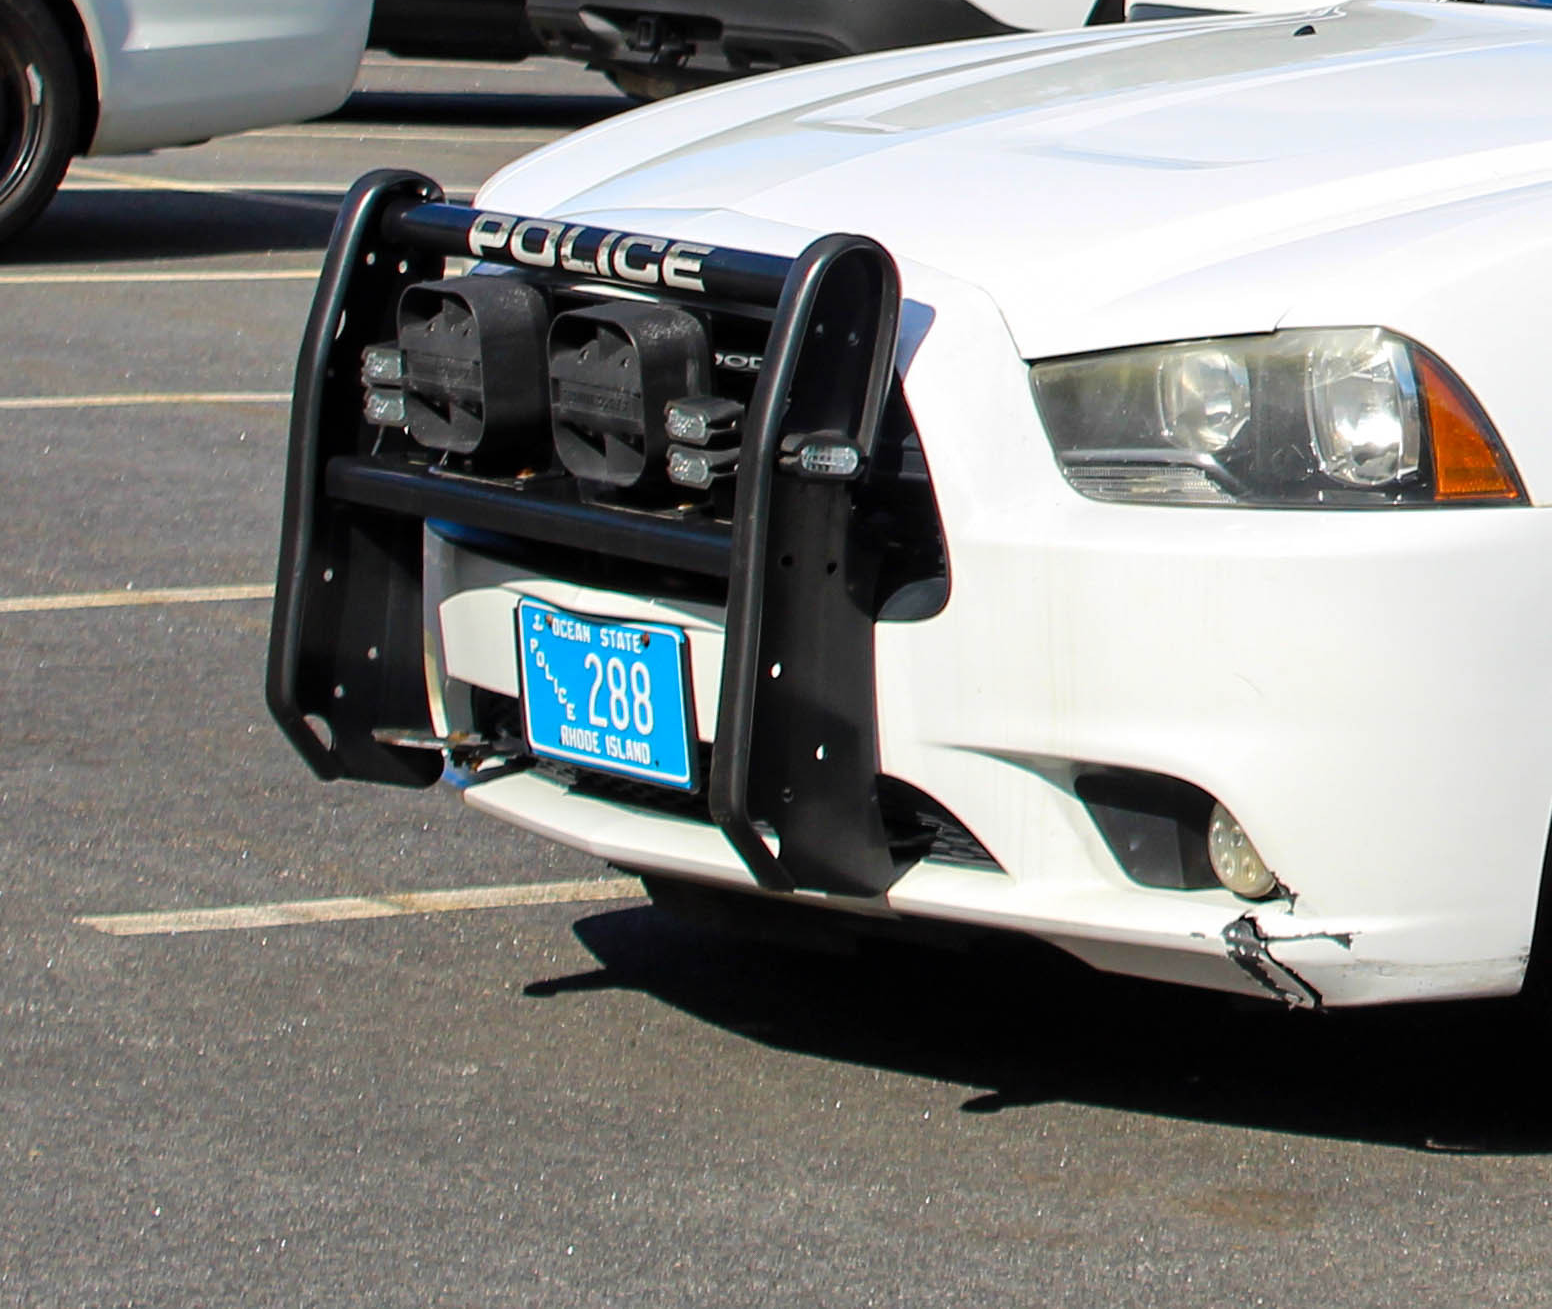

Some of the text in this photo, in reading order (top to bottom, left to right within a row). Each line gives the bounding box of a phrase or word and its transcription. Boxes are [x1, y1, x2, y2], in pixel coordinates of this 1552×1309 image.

[467, 212, 717, 292] POLICE
[552, 615, 642, 654] OCEAN STATE
[529, 637, 577, 721] POLICE
[584, 652, 654, 735] 288
[559, 724, 650, 765] RHODE ISLAND
